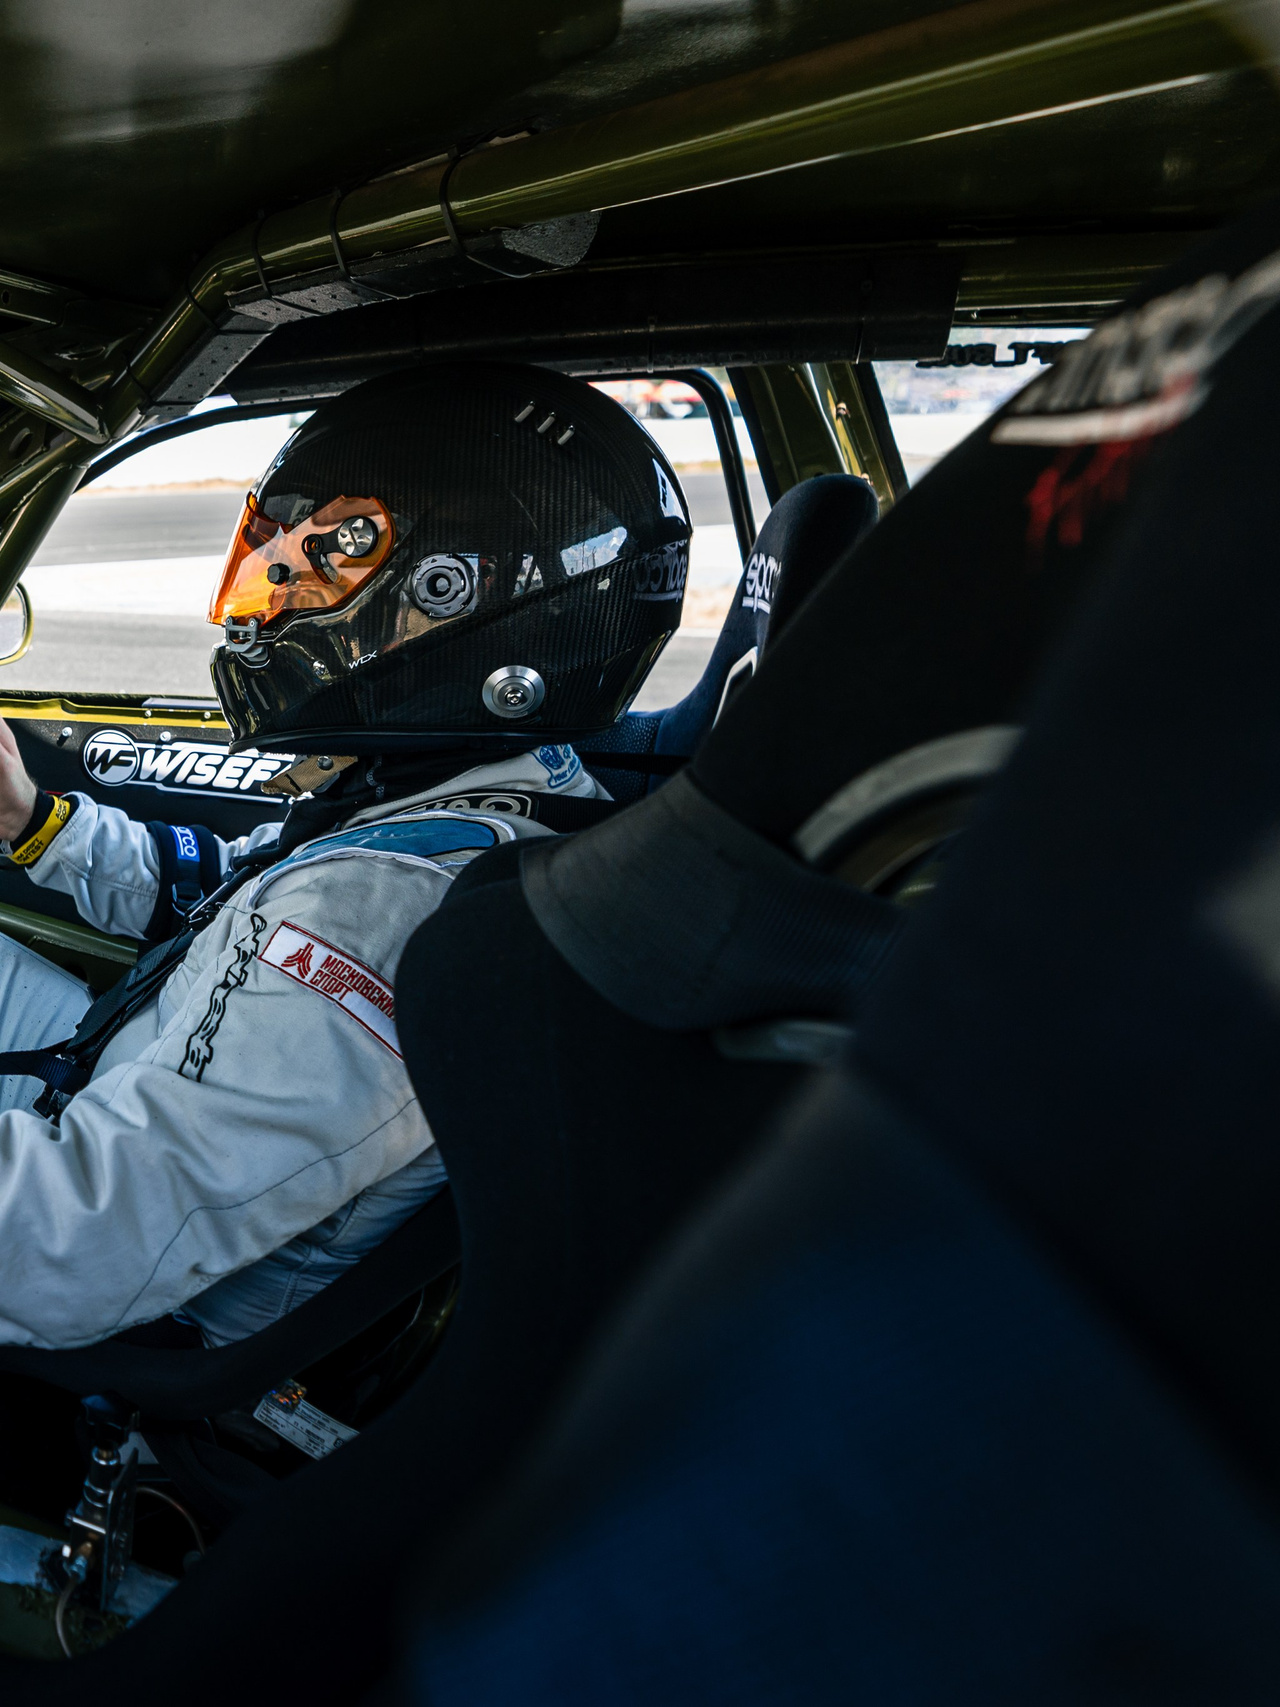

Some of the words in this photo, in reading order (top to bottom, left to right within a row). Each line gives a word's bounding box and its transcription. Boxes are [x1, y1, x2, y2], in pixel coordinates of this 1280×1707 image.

[138, 746, 293, 790] WISEF
[309, 969, 354, 1001] СПОРТ
[320, 954, 395, 1019] МОСКОВСКИ
